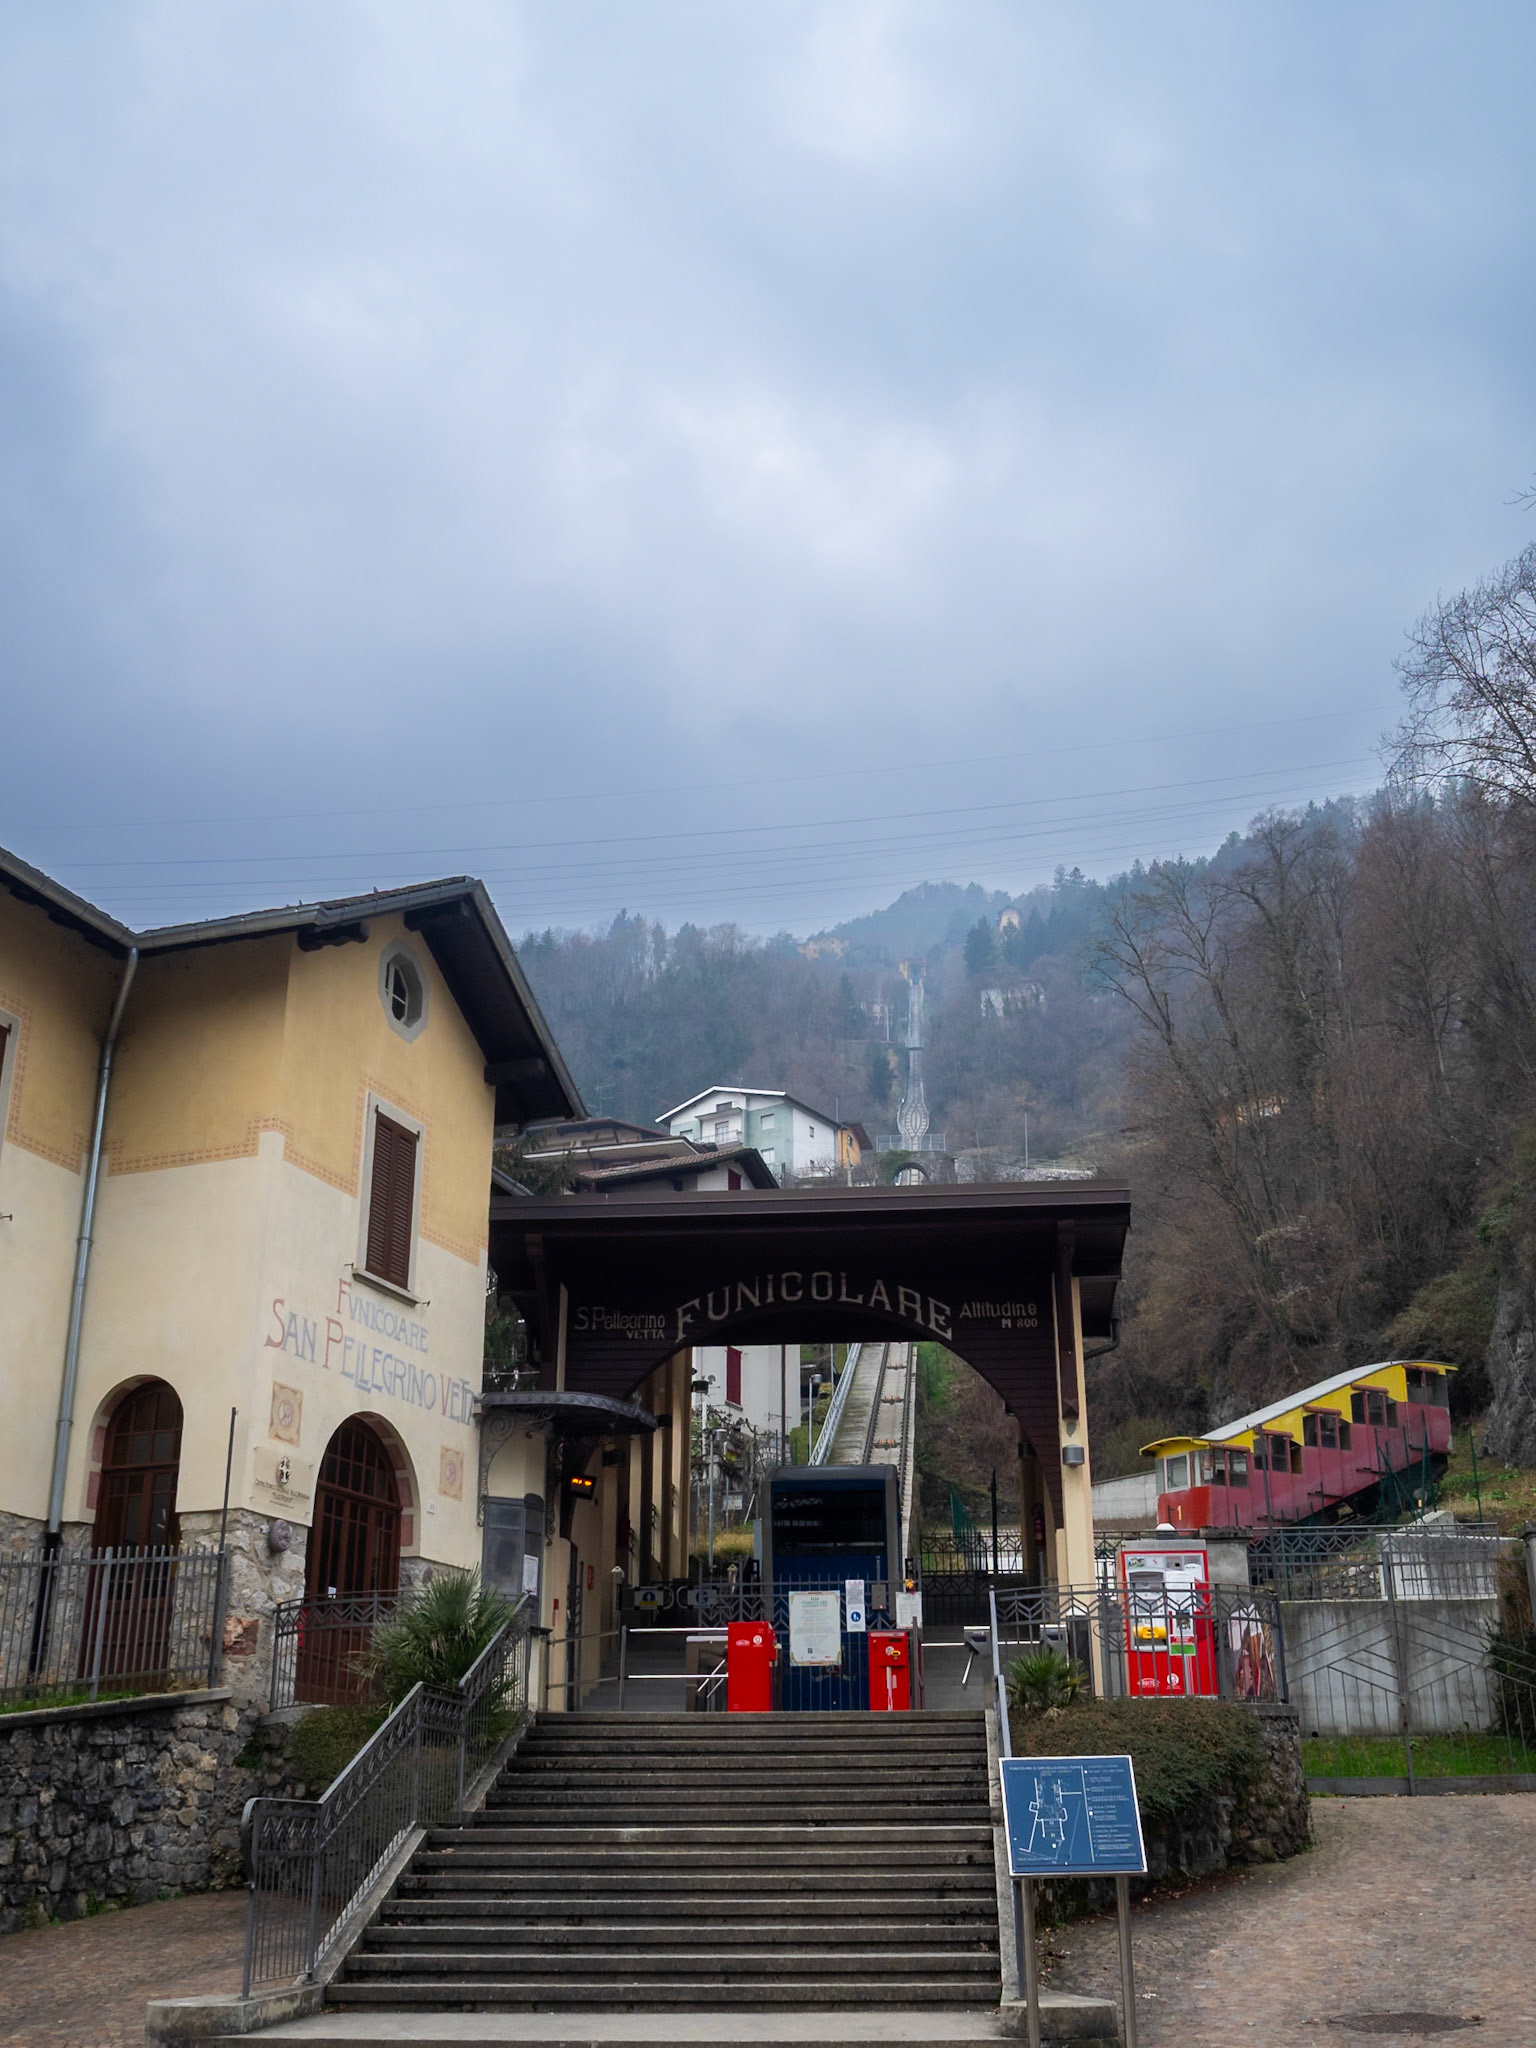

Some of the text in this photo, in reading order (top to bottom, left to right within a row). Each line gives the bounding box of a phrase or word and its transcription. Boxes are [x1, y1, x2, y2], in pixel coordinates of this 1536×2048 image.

[674, 1271, 952, 1343] FUNICOLARE
[959, 1302, 1037, 1318] Altitudine
[1016, 1318, 1038, 1328] 800
[625, 1329, 665, 1340] VETTA
[264, 1298, 317, 1364] SAN
[323, 1317, 436, 1410] PELLEGRINO
[1176, 1504, 1182, 1521] 1
